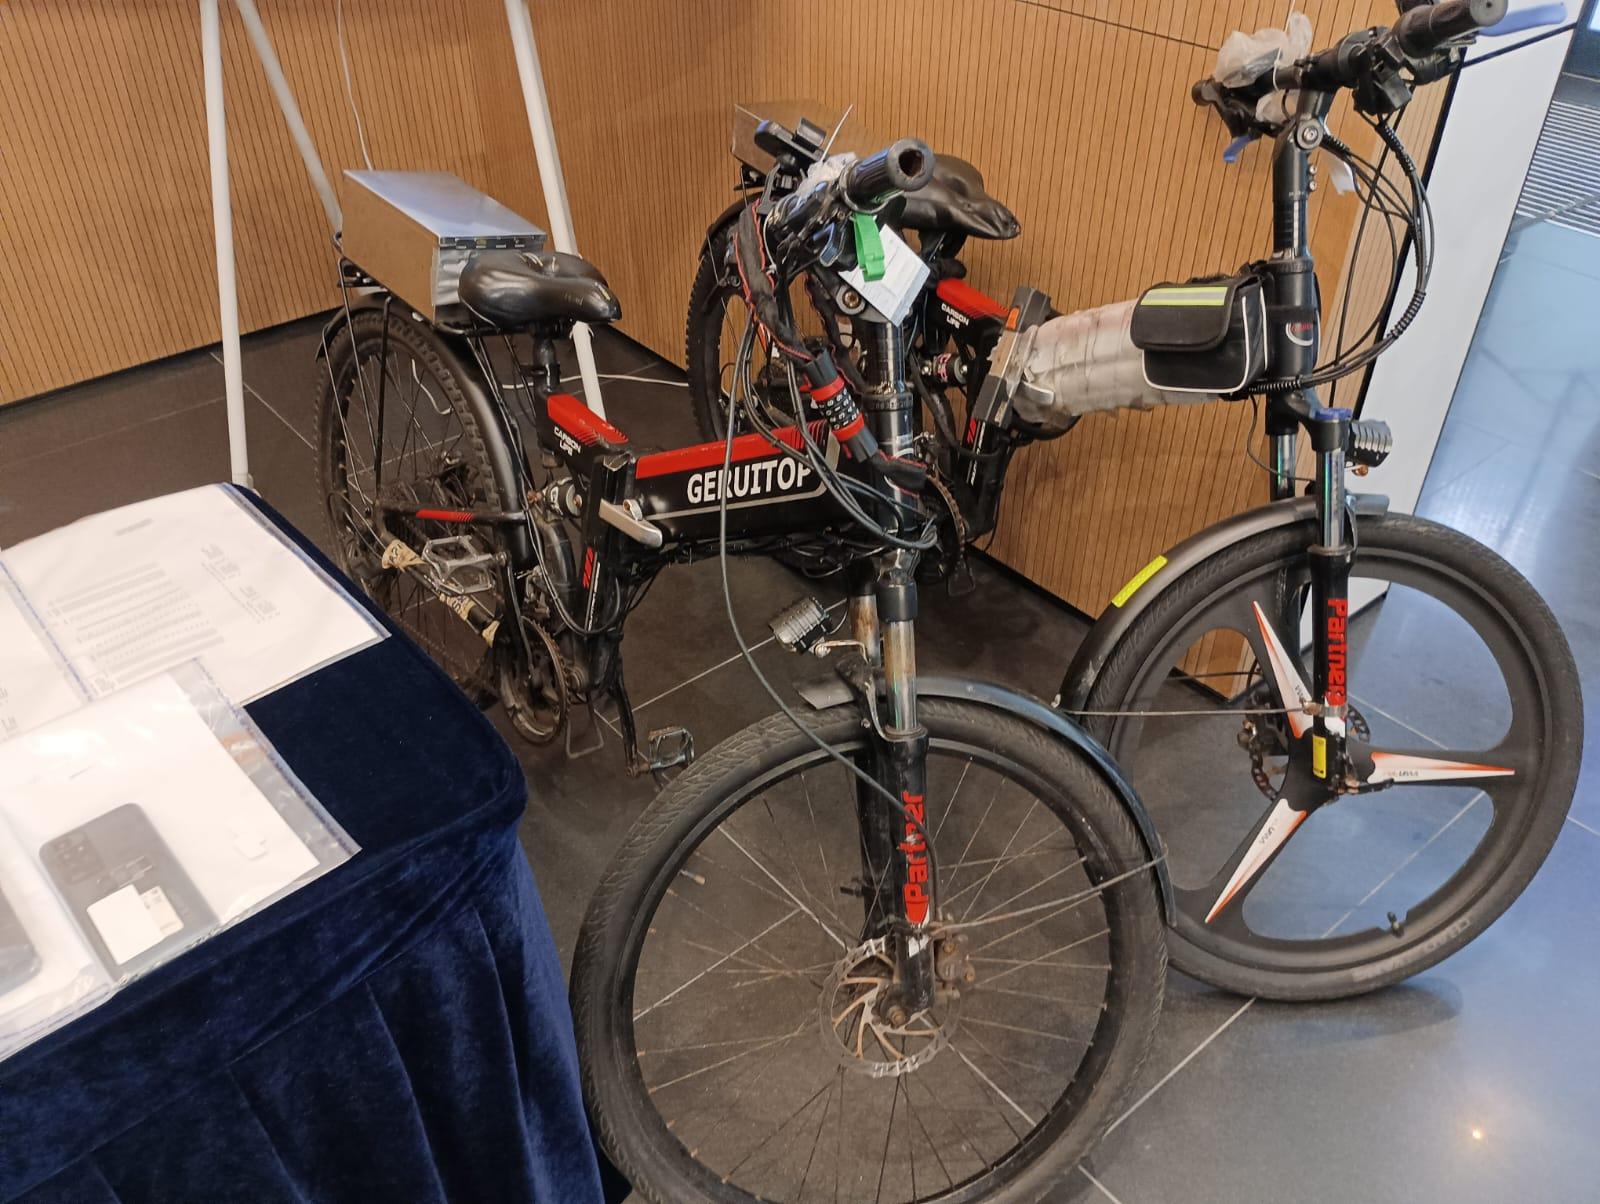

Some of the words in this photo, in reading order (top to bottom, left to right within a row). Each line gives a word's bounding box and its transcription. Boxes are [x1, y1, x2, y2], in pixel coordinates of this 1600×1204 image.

[941, 302, 970, 326] CARBON
[554, 422, 582, 454] CARBON
[686, 456, 812, 504] GERUITOP
